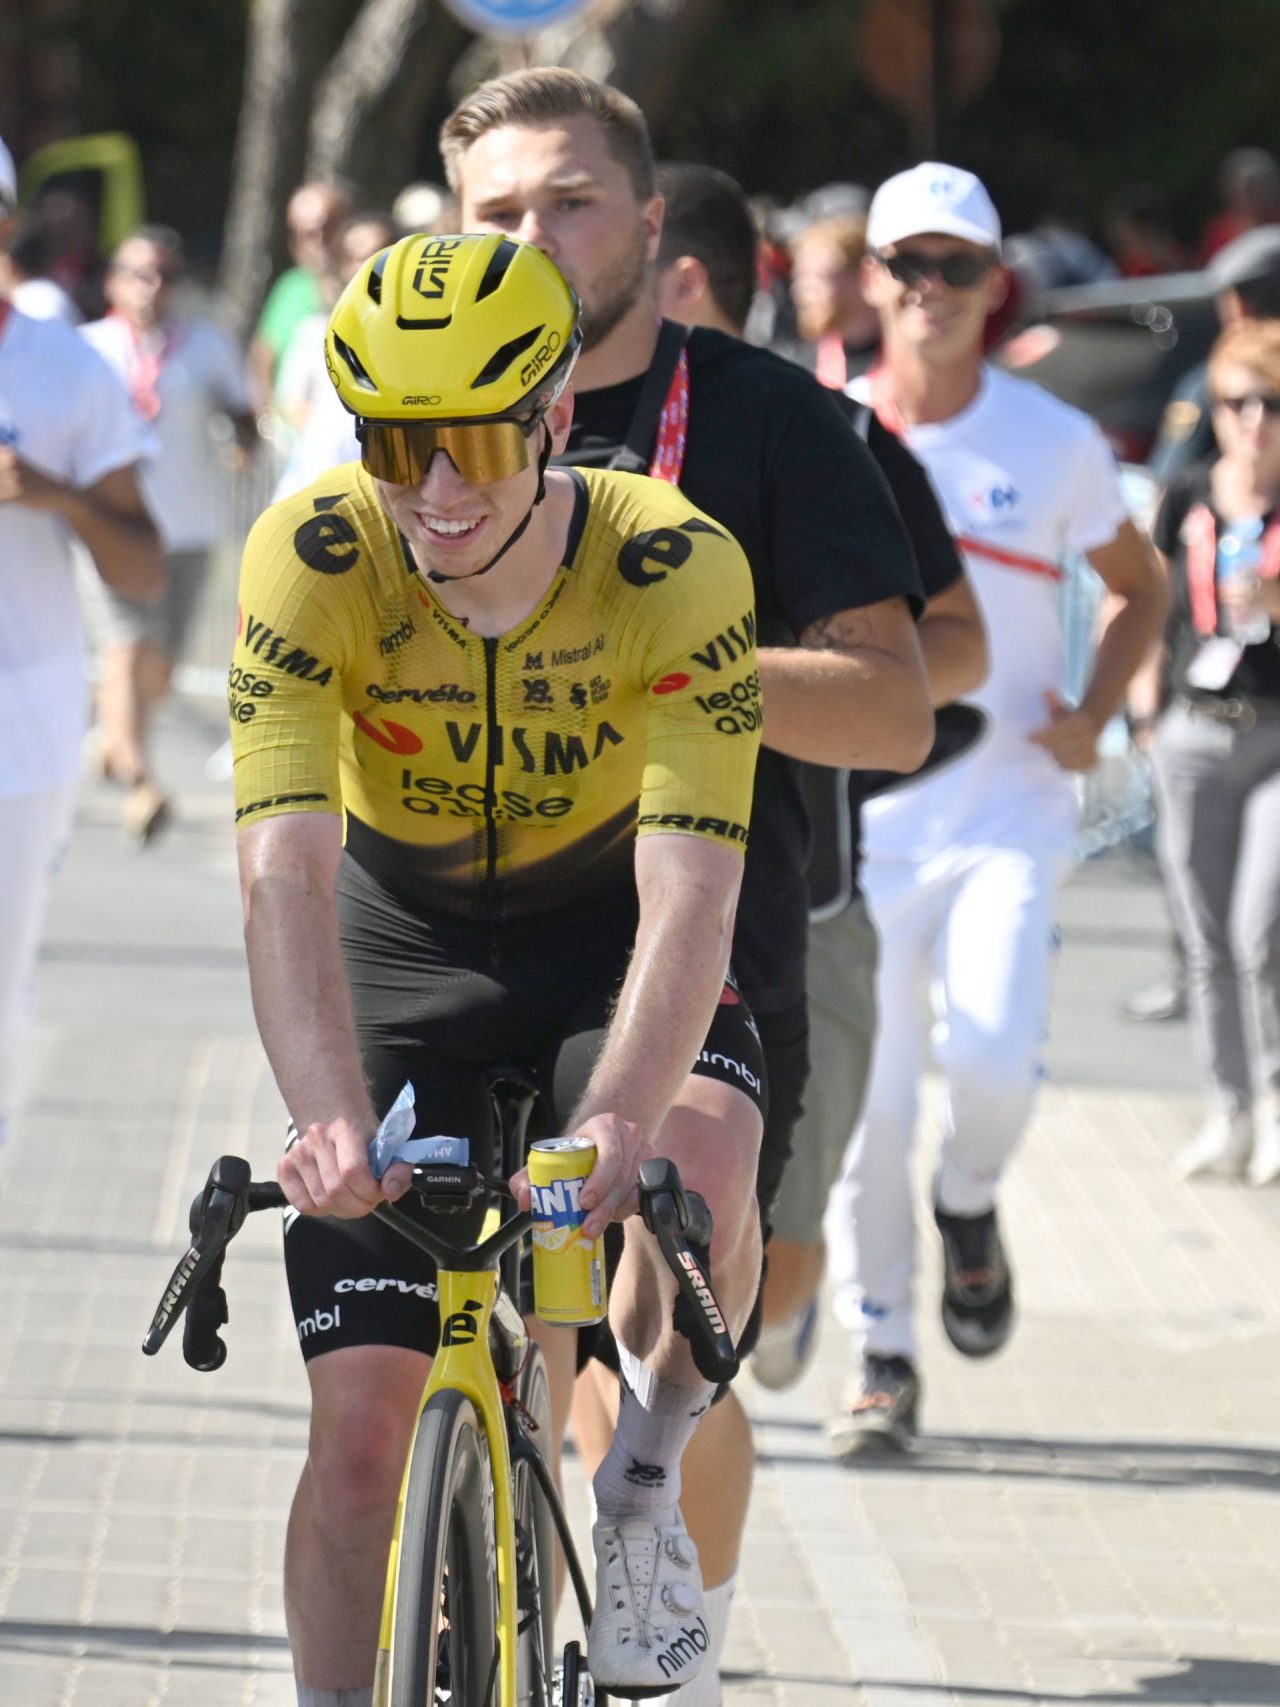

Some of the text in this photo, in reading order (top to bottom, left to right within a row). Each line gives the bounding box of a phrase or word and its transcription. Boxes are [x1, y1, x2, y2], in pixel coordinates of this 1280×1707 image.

[520, 331, 561, 387] GIRO
[402, 395, 441, 405] GIRO
[245, 614, 334, 688] VISMA
[431, 608, 468, 650] VISMA
[690, 611, 756, 672] VISM
[551, 641, 592, 667] Mistral
[229, 663, 274, 697] ase
[445, 720, 625, 776] VISMA
[402, 769, 574, 818] lease
[696, 1050, 760, 1095] imbl
[426, 1175, 461, 1183] GARMIN
[530, 1179, 583, 1216] ANT
[153, 1248, 201, 1330] SRAM
[676, 1251, 726, 1335] SRAM
[297, 1304, 340, 1340] mbl
[657, 1616, 711, 1679] nimbl
